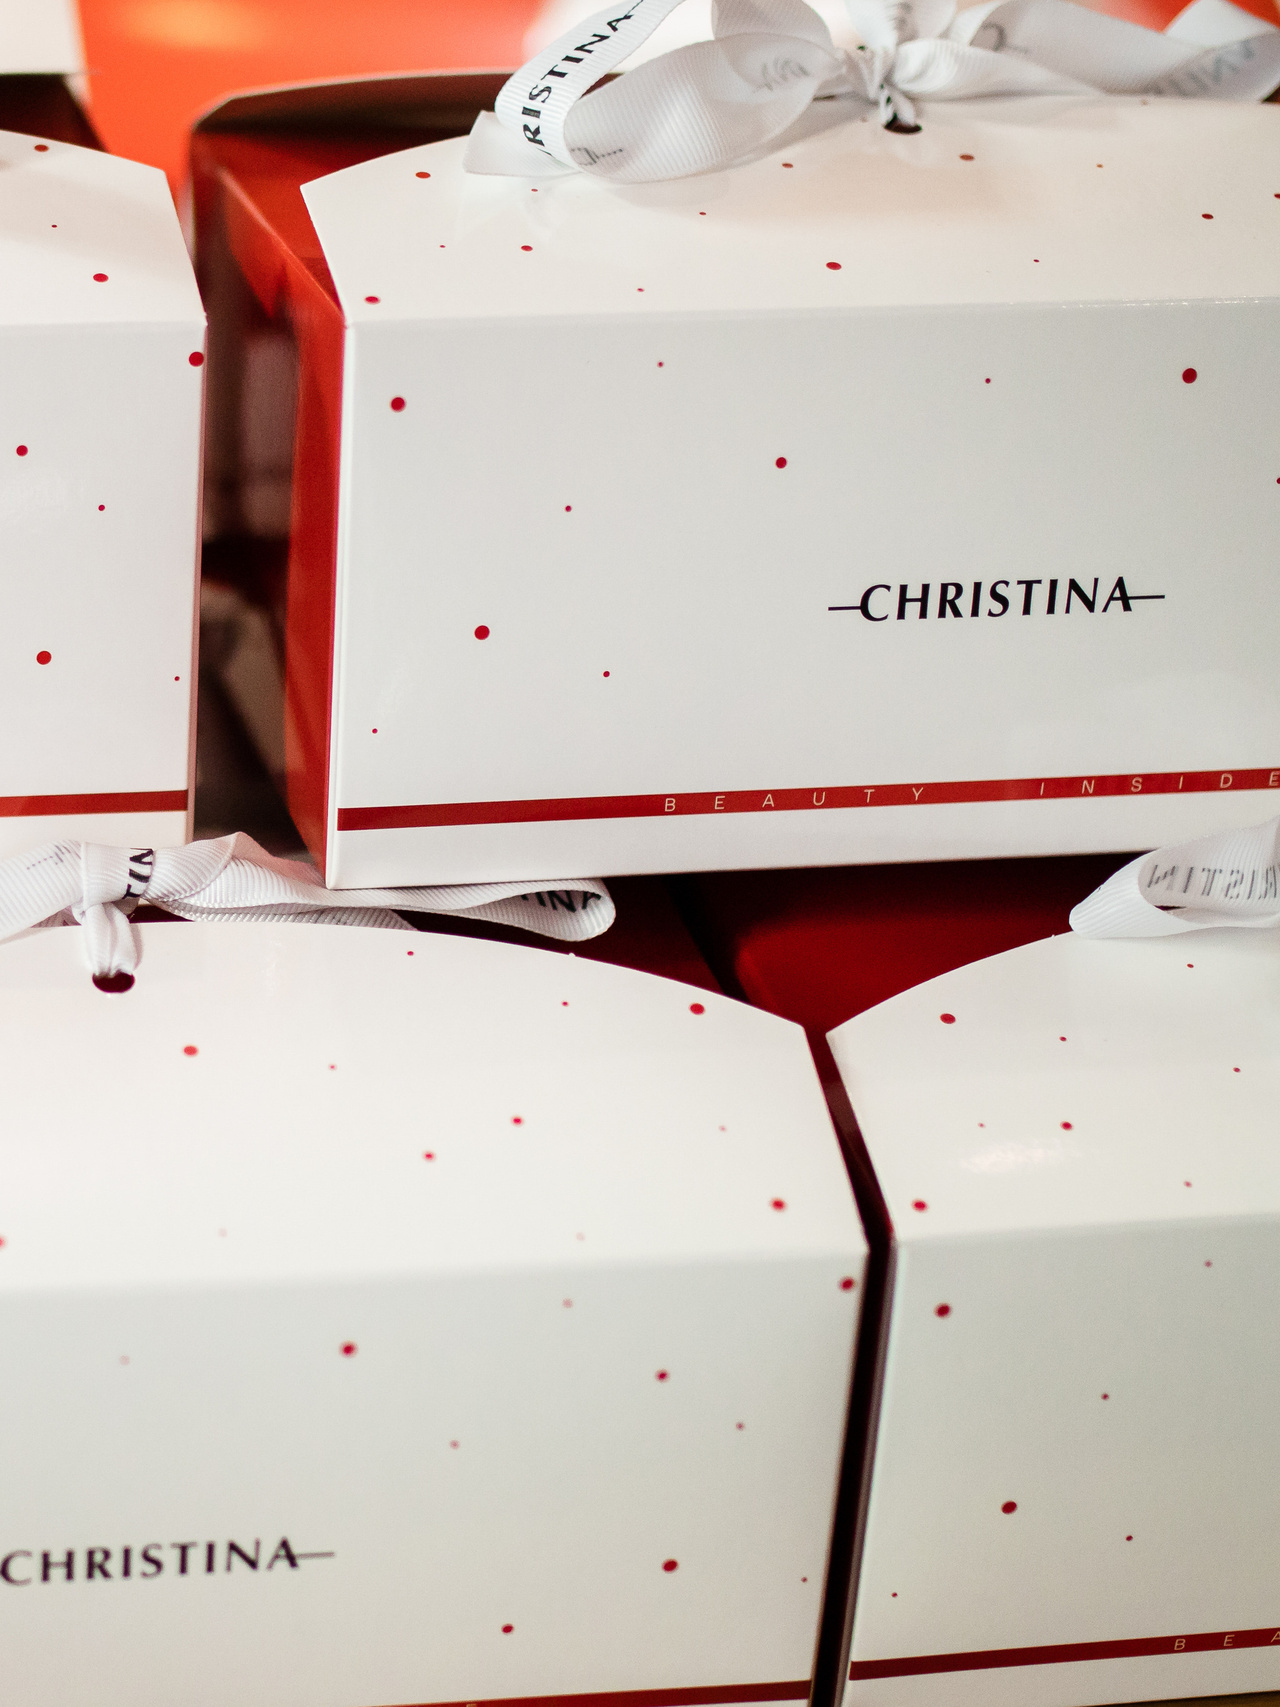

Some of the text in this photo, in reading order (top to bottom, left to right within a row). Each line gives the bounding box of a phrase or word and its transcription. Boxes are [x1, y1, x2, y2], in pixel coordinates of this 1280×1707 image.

[521, 13, 634, 152] RISTINA
[859, 575, 1133, 622] CHRISTINA
[664, 771, 1280, 812] BEAUTY INSIDE
[0, 1536, 300, 1587] CHRISTINA
